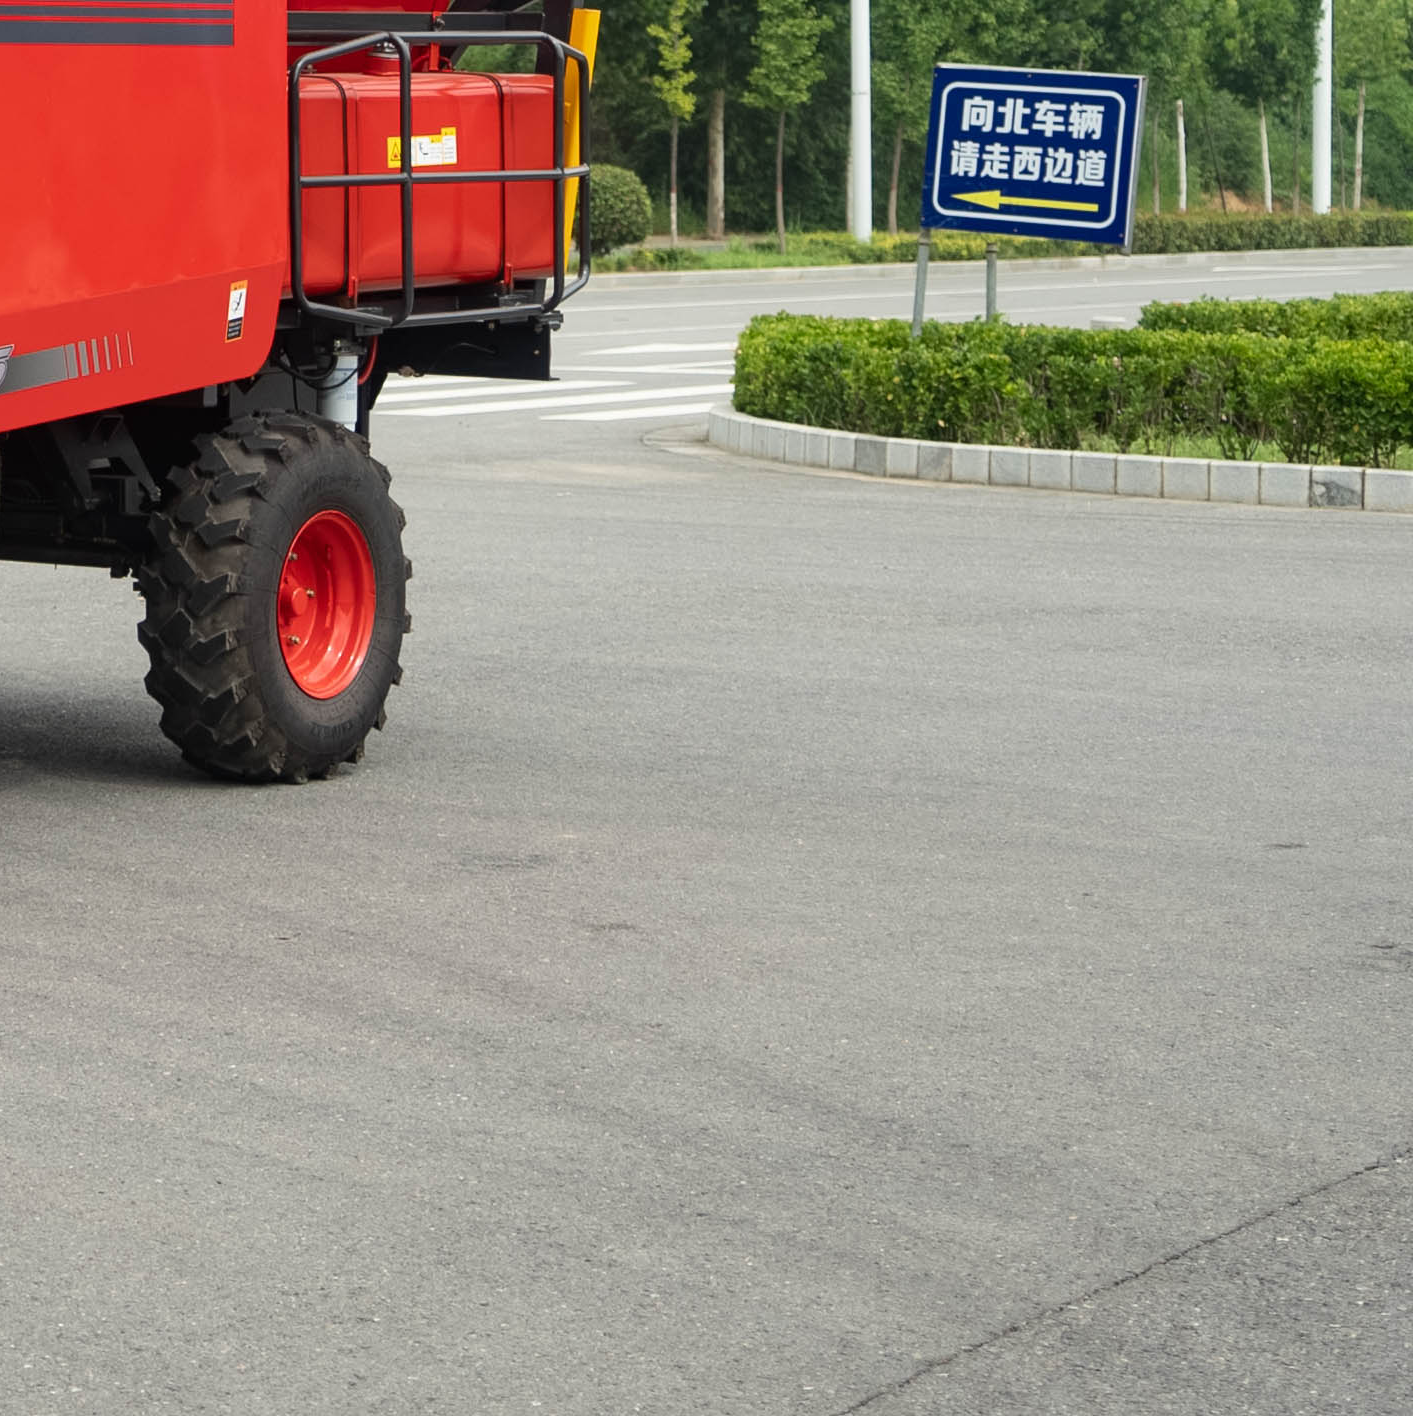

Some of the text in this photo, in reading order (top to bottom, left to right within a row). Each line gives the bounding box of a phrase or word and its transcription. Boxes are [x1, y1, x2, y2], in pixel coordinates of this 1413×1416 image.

[961, 96, 1105, 140] 向北车辆
[950, 140, 1108, 187] 请走西边道
